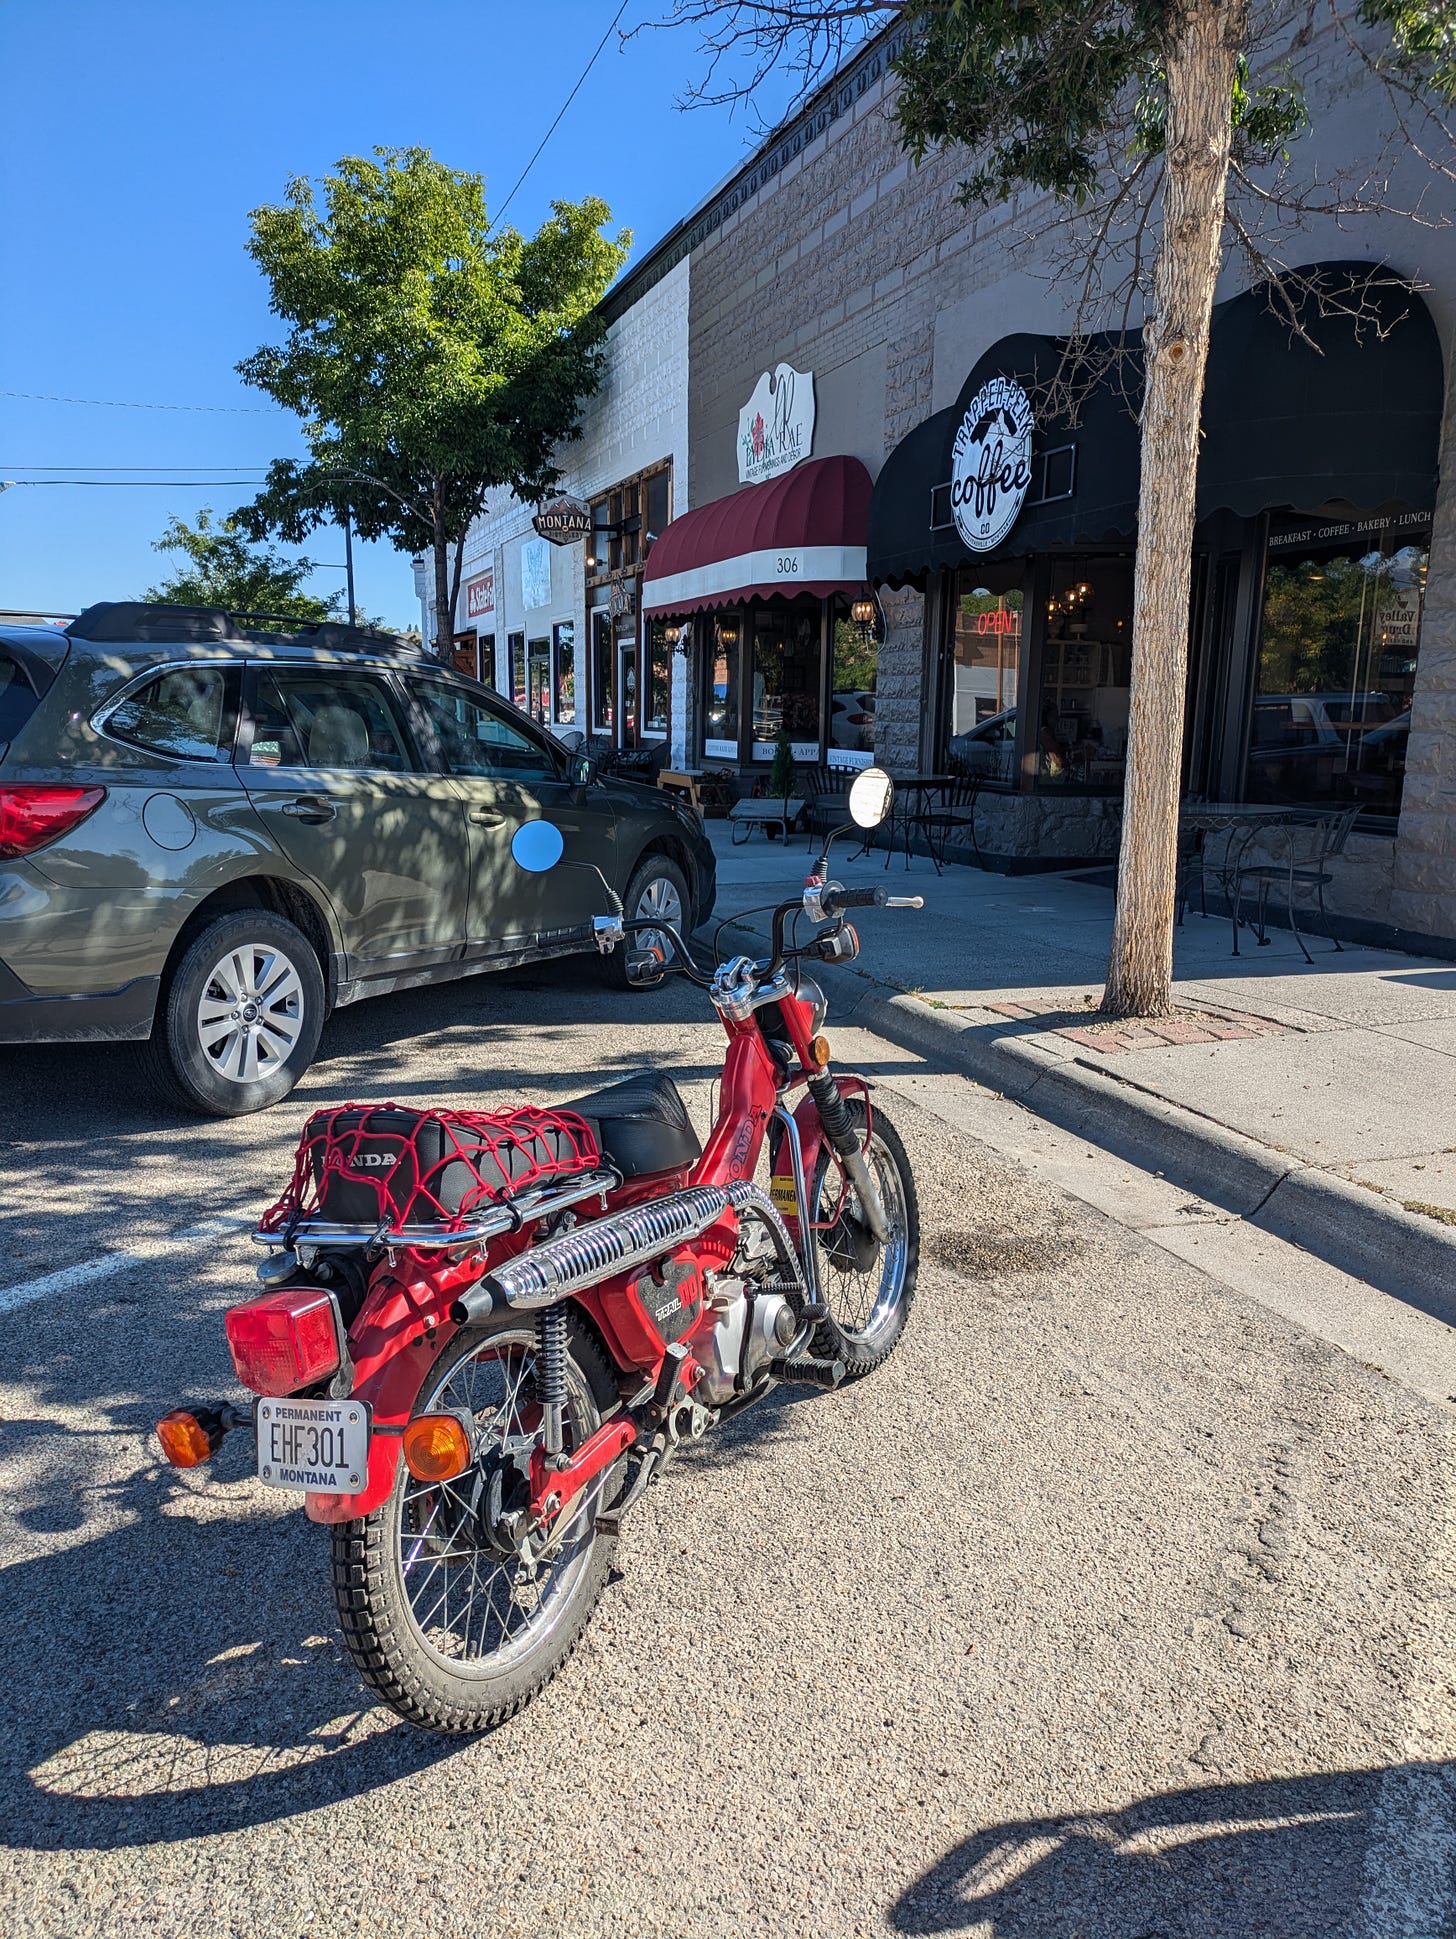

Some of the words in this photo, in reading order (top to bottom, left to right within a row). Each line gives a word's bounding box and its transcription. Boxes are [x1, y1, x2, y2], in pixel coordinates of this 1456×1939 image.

[952, 377, 1006, 459] TRAPPER
[1005, 379, 1035, 440] PEAK
[952, 440, 1032, 518] coffee
[538, 514, 591, 531] MONTANA
[1268, 530, 1312, 547] BREAKFAST
[1318, 523, 1350, 539] COFFEE
[1356, 516, 1392, 532] BAKERY
[1398, 511, 1432, 526] LUNCH
[776, 556, 798, 574] 306
[977, 609, 1013, 636] OPEN
[320, 1153, 402, 1168] NDA
[655, 1297, 682, 1322] TRAIL
[275, 1407, 342, 1422] PERMANENT
[270, 1422, 350, 1469] EHF301
[279, 1468, 337, 1486] MONTANA
